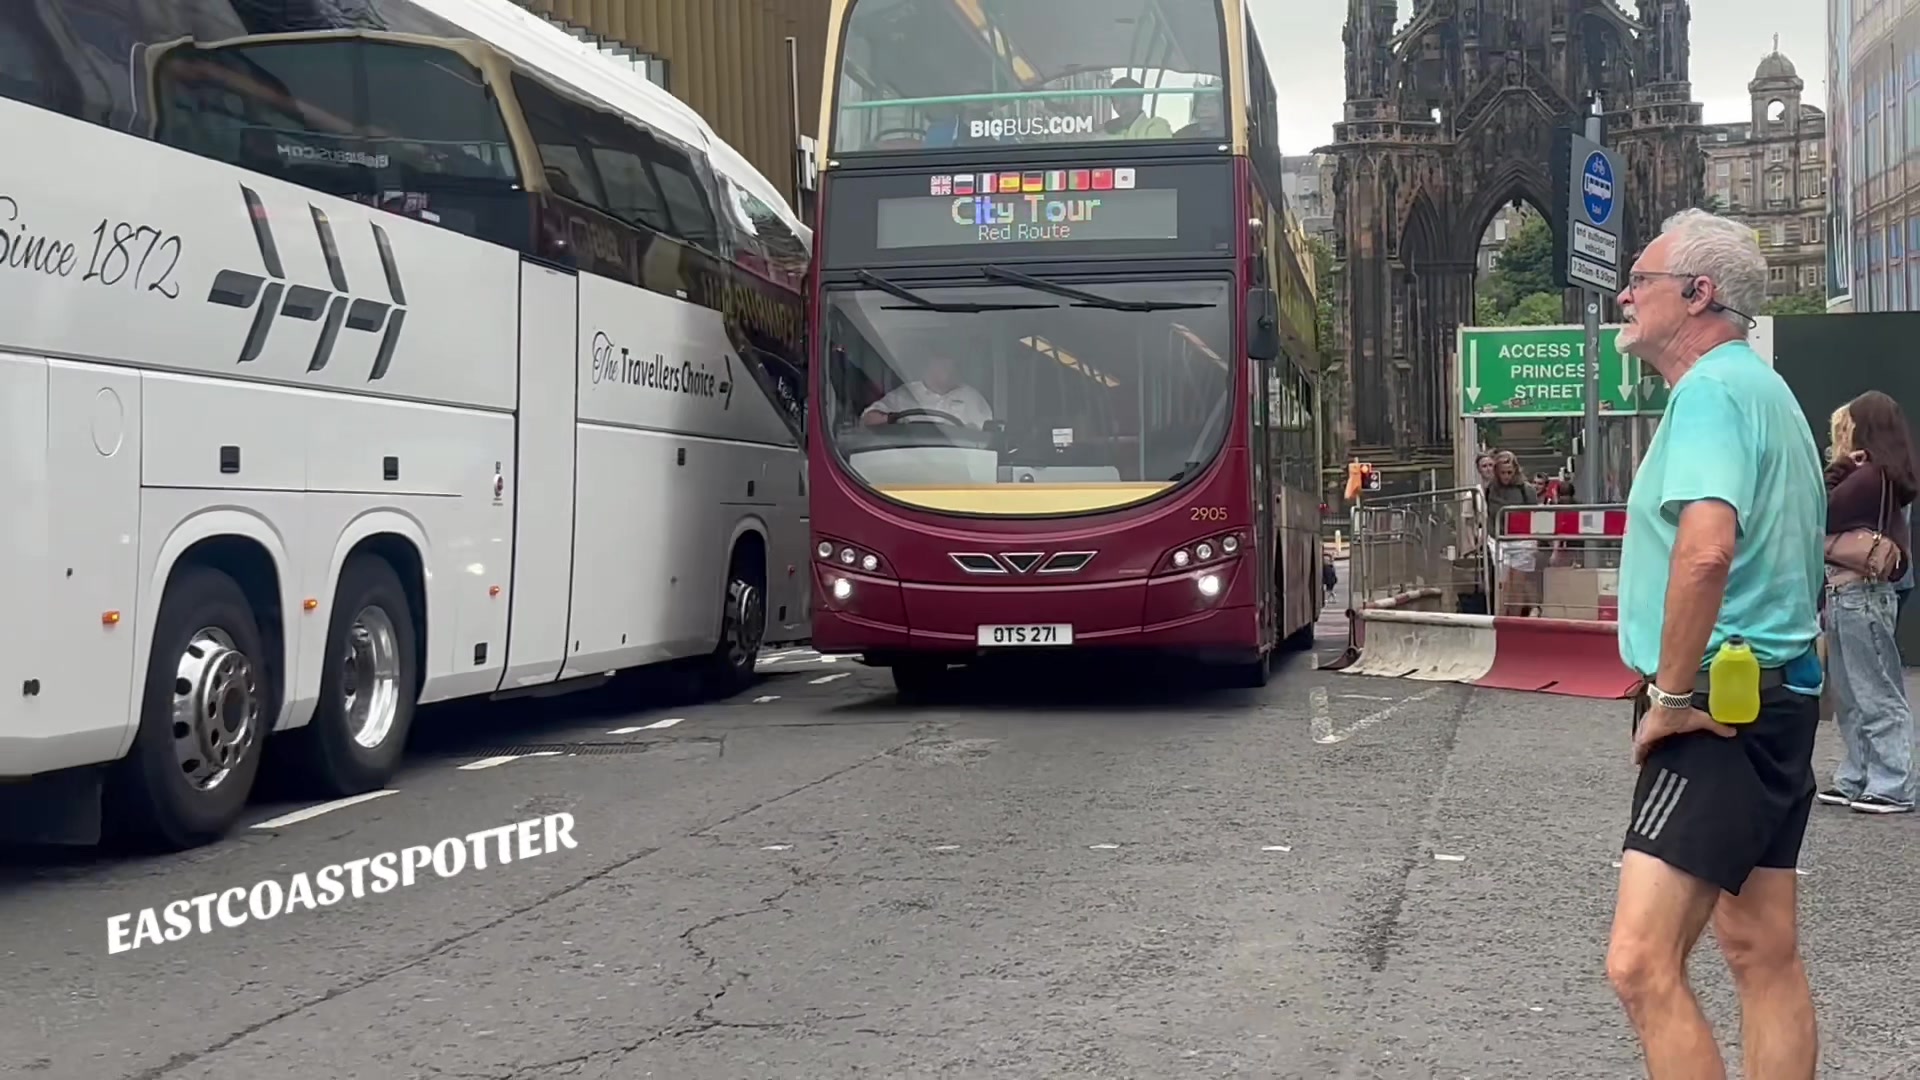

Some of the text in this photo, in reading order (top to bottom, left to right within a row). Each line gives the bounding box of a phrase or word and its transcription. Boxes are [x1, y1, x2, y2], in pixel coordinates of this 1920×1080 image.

[970, 115, 1093, 138] BIGBUS.COM
[951, 194, 1101, 225] City Tour
[978, 223, 1071, 241] Red Route
[82, 218, 182, 299] 1872
[1499, 343, 1571, 358] ACCESS
[592, 330, 715, 398] The Travellers Choice
[1511, 364, 1586, 379] PRINCES
[1514, 384, 1584, 399] STREET
[1190, 507, 1228, 521] 2905
[994, 626, 1057, 643] OTS 271
